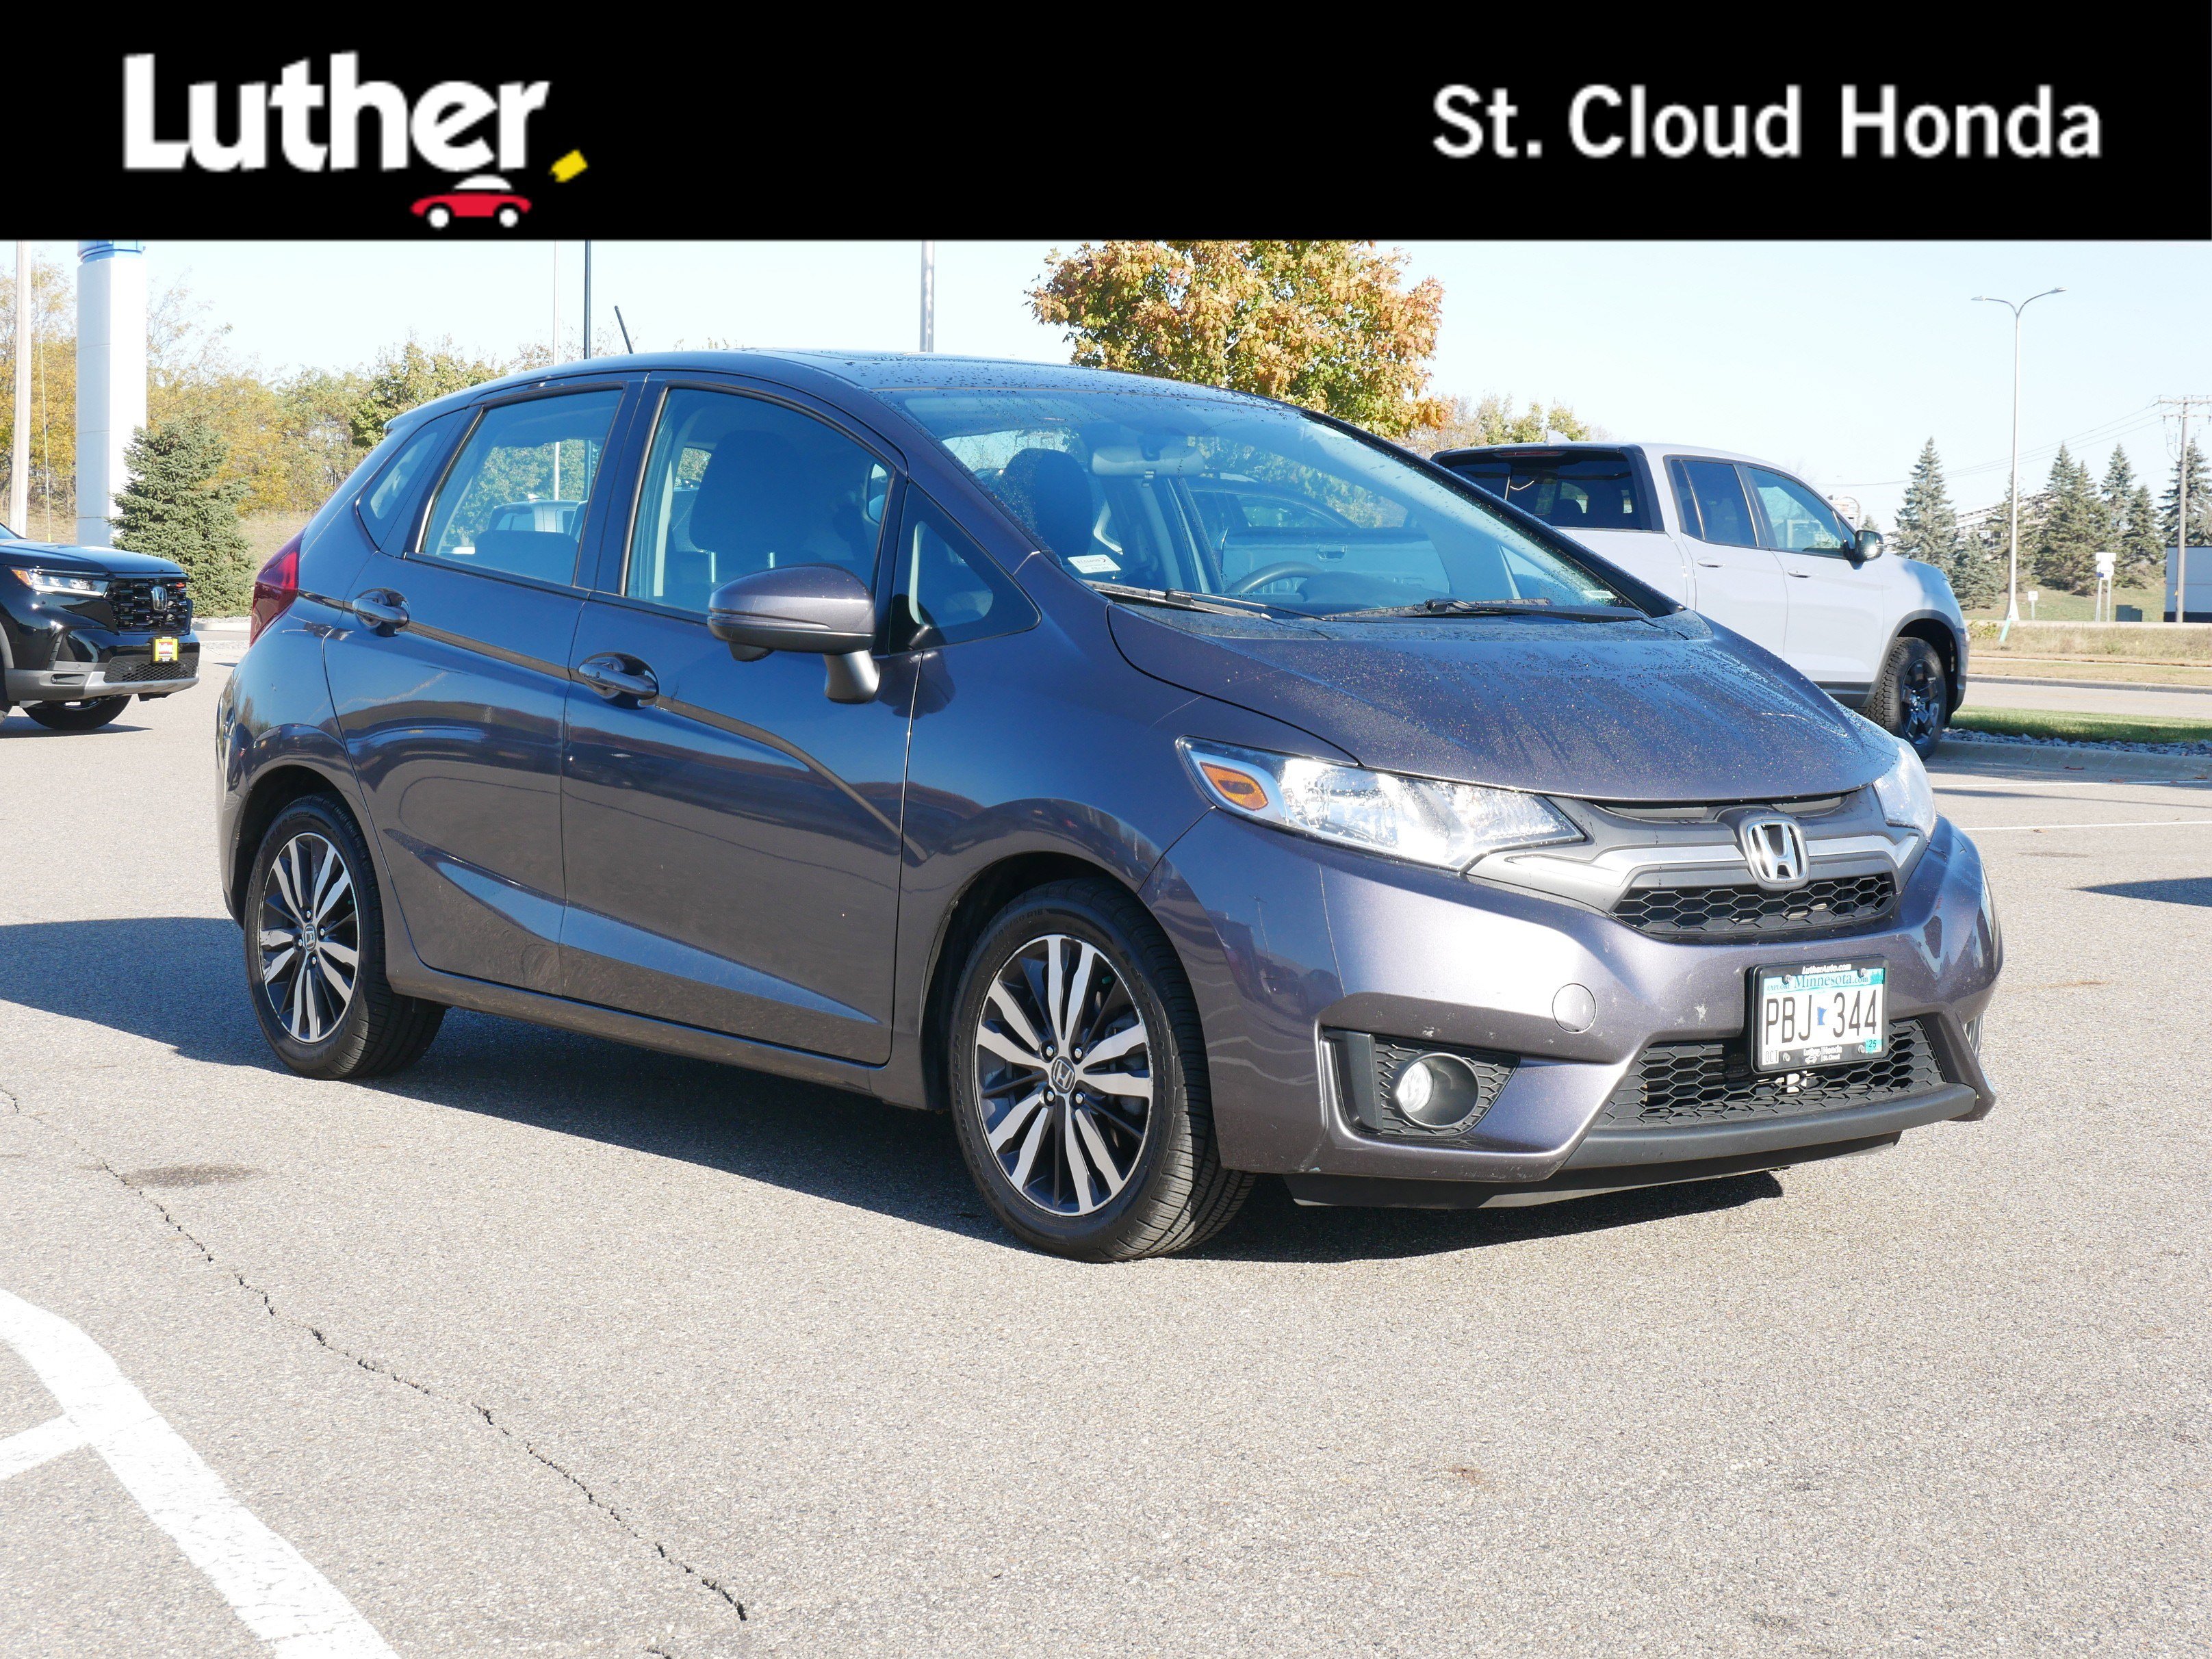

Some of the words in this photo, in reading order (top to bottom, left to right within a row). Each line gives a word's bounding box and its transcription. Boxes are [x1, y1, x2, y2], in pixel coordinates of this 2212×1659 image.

[1802, 964, 1852, 975] LutherAuto.com
[1766, 994, 1812, 1045] PBJ
[1833, 990, 1877, 1038] 344
[1765, 1050, 1779, 1063] OCT
